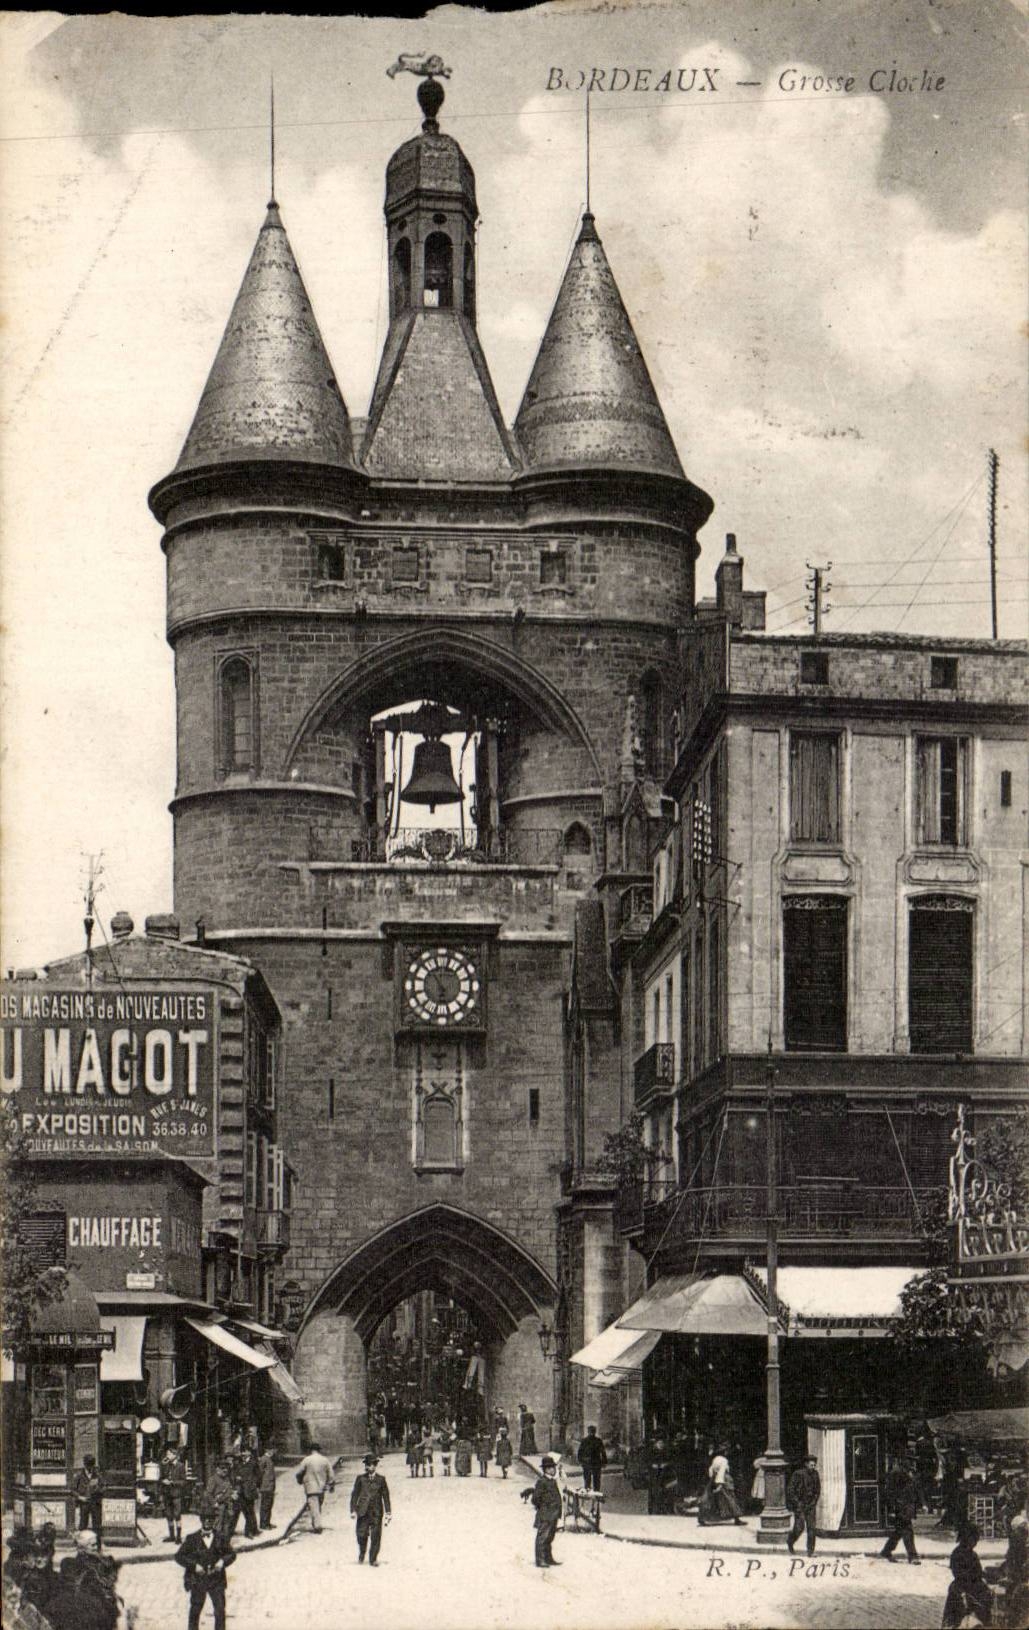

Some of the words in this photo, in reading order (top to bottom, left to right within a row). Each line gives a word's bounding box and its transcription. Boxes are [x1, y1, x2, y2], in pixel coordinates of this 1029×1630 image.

[23, 995, 94, 1018] MAGASINS
[97, 998, 114, 1019] de
[116, 996, 206, 1019] NOUVEAUTES
[44, 1027, 208, 1095] MAGOT
[22, 1114, 145, 1136] EXPOSITION
[69, 1217, 161, 1247] CHAUFFAGE
